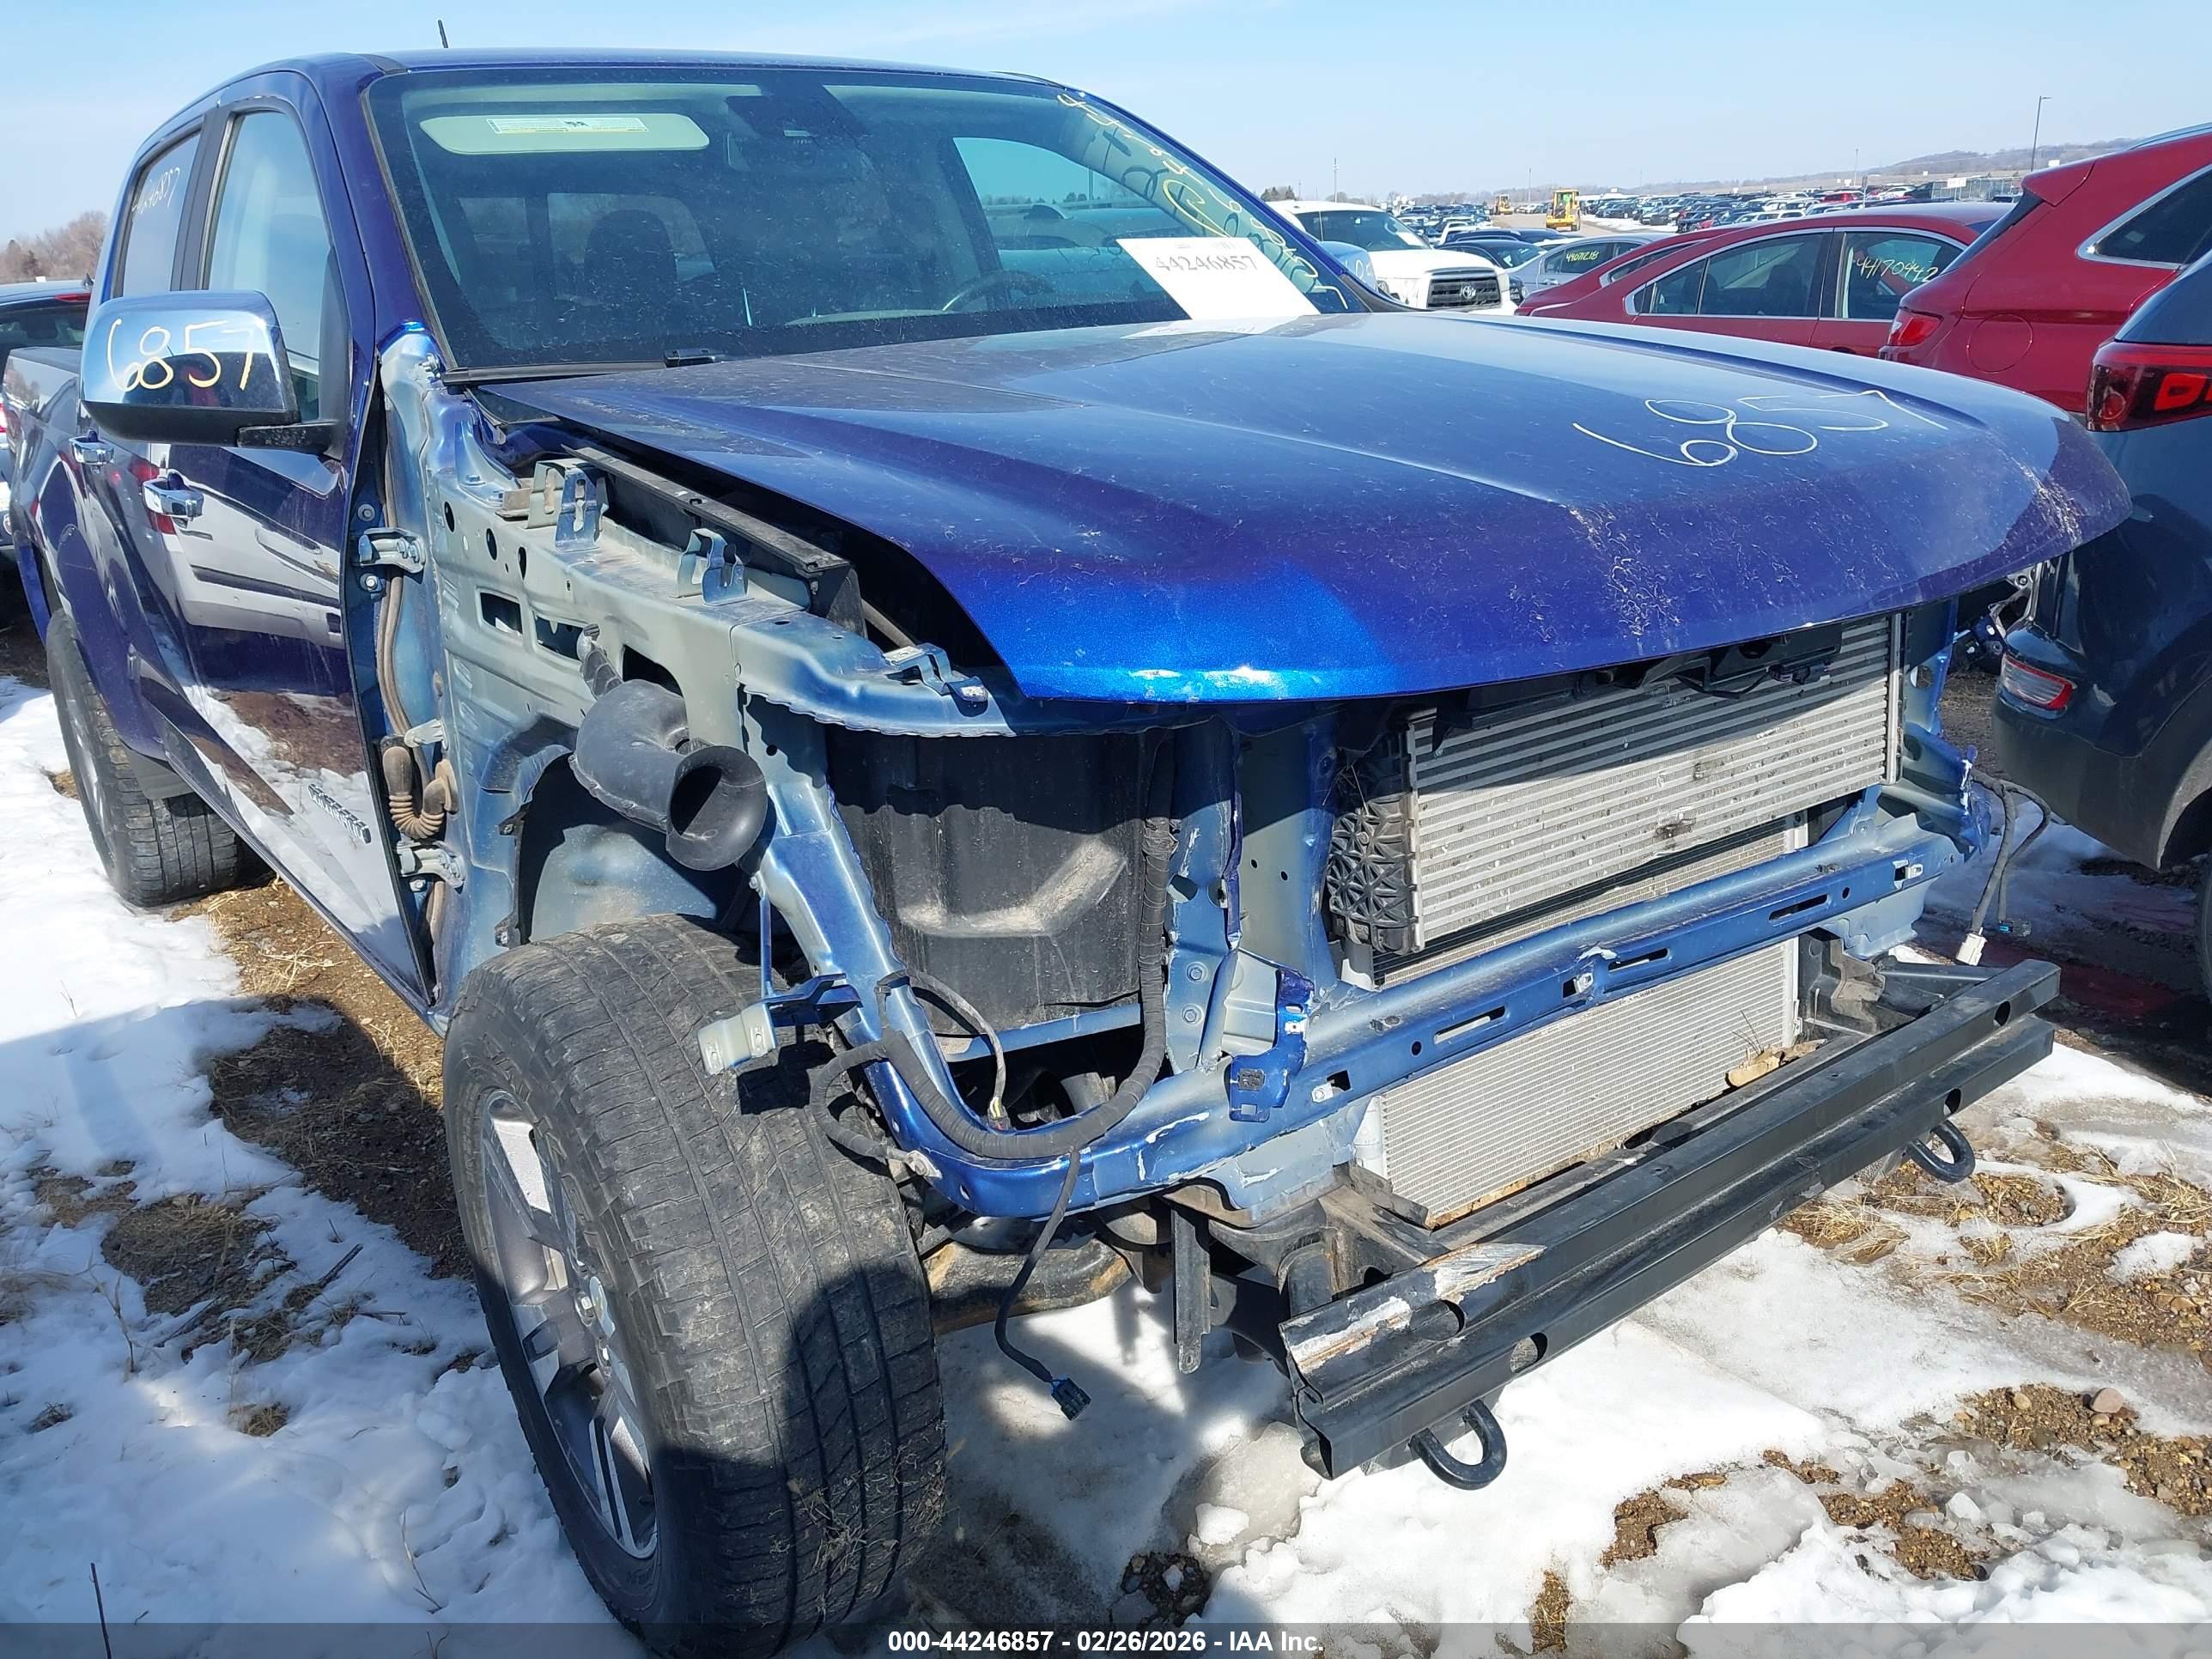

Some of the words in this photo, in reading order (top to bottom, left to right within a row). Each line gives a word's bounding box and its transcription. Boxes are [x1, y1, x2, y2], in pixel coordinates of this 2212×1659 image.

[1156, 255, 1259, 272] 44246857
[1856, 256, 1939, 283] 44170442
[107, 318, 254, 392] 6857
[1572, 389, 1948, 466] 6857
